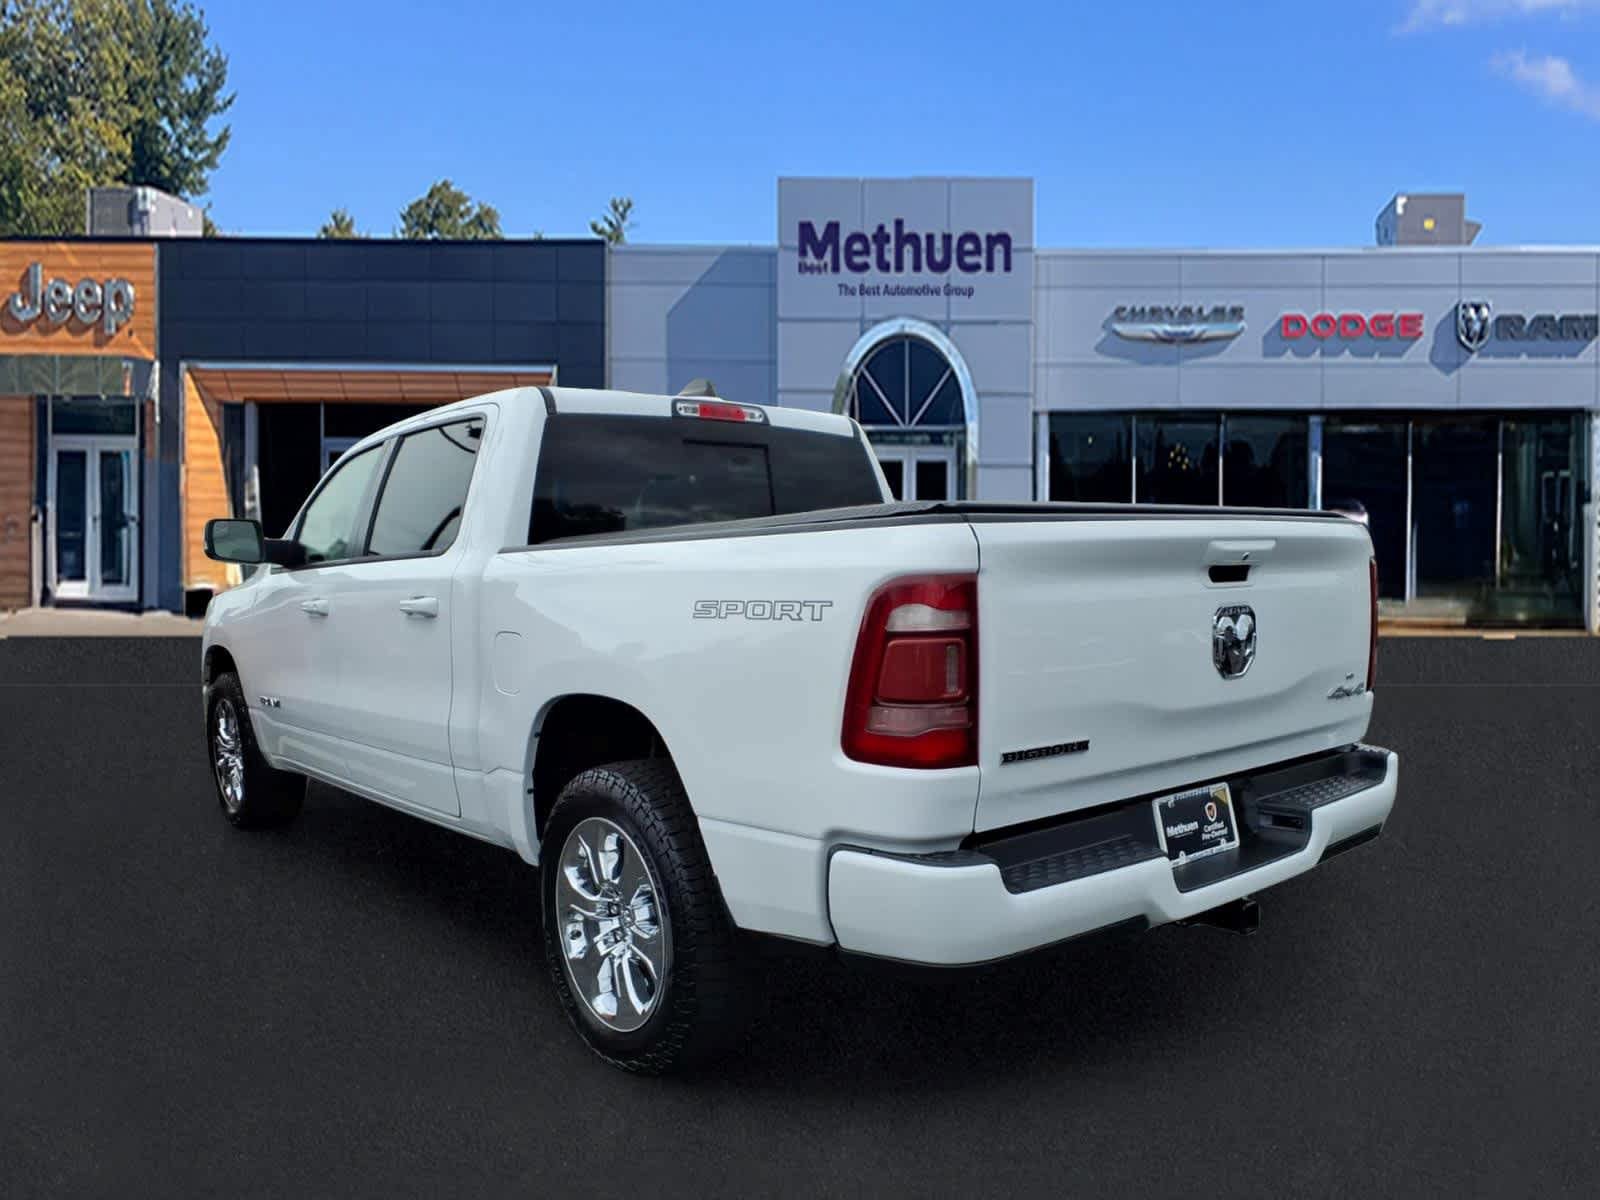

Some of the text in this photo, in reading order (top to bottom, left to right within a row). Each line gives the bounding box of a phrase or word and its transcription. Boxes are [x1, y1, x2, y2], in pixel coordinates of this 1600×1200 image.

[798, 218, 1012, 274] Methuen
[9, 262, 135, 335] Jeep
[838, 282, 975, 299] The Best Automotive Group
[1114, 305, 1245, 322] CHRYSLER
[1280, 313, 1424, 340] DODGE
[1495, 314, 1599, 341] RAM
[693, 600, 834, 621] SPORT
